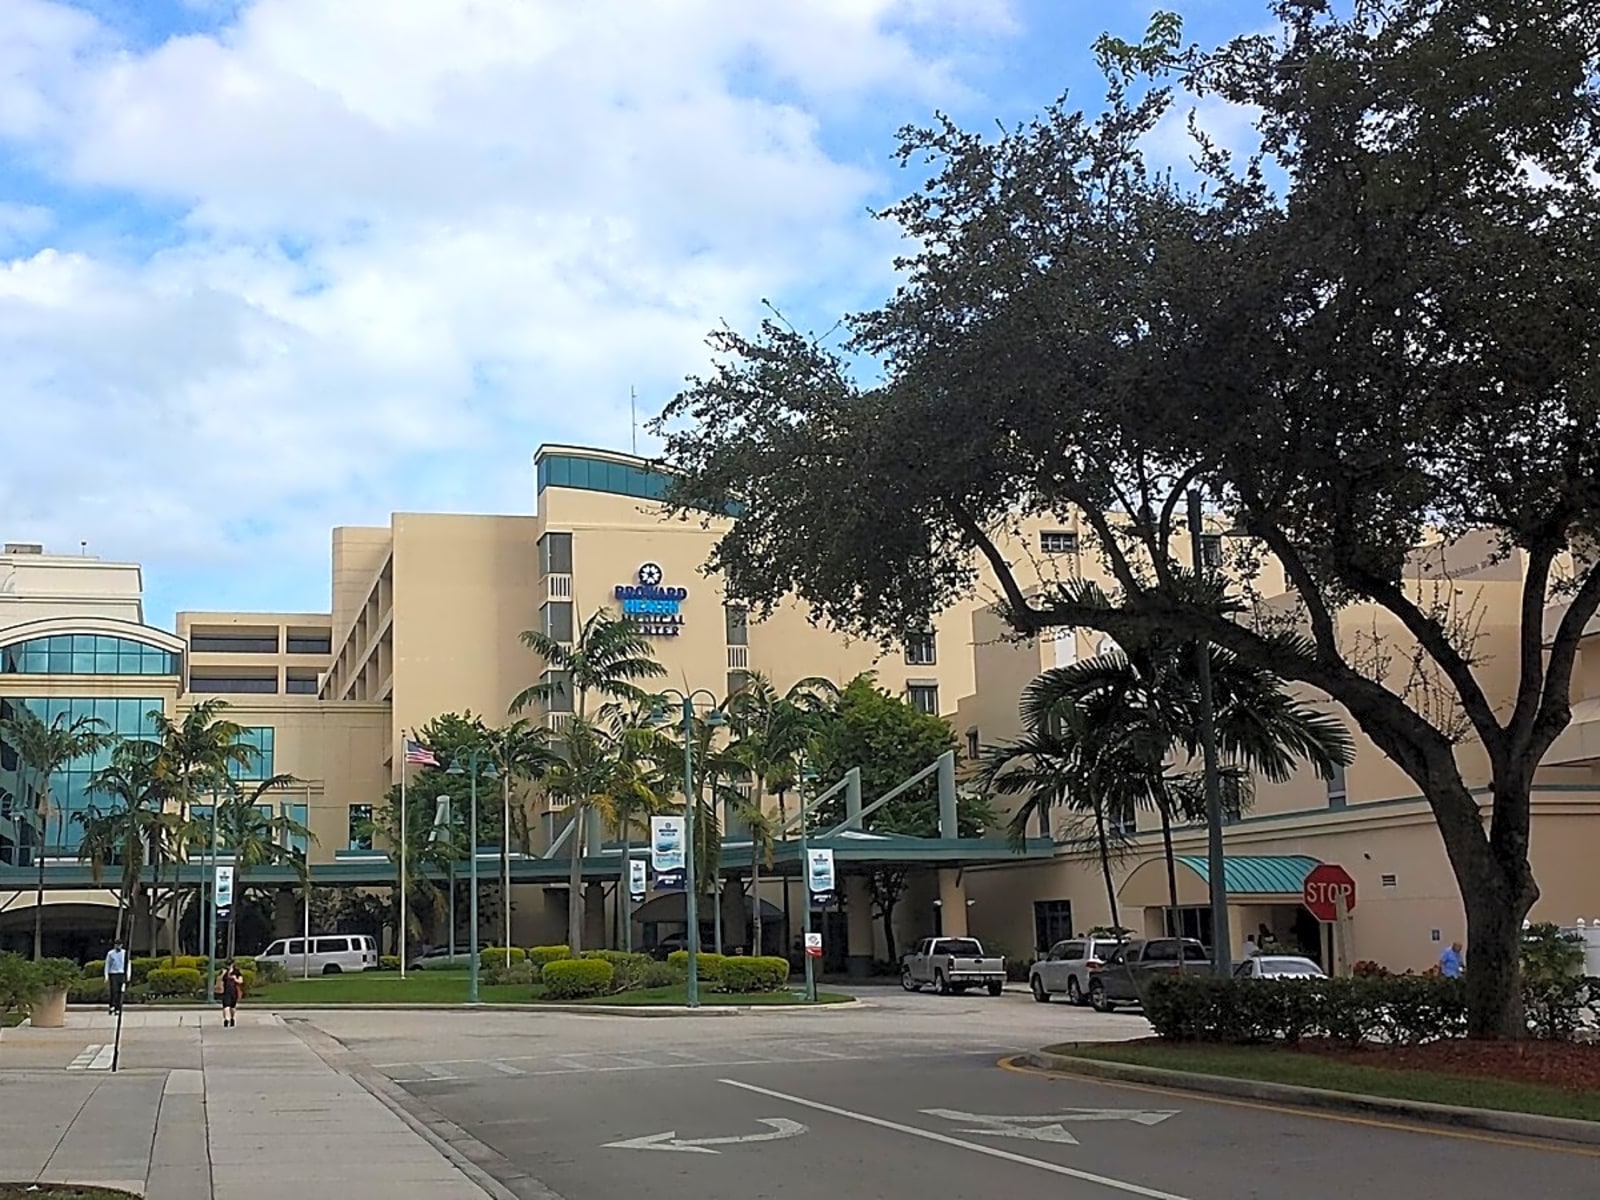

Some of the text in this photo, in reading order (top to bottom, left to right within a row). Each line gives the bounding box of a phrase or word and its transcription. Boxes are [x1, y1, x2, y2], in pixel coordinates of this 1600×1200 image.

[615, 586, 687, 600] BROWARD
[623, 600, 679, 614] HEALTH
[1307, 882, 1352, 903] STOP
